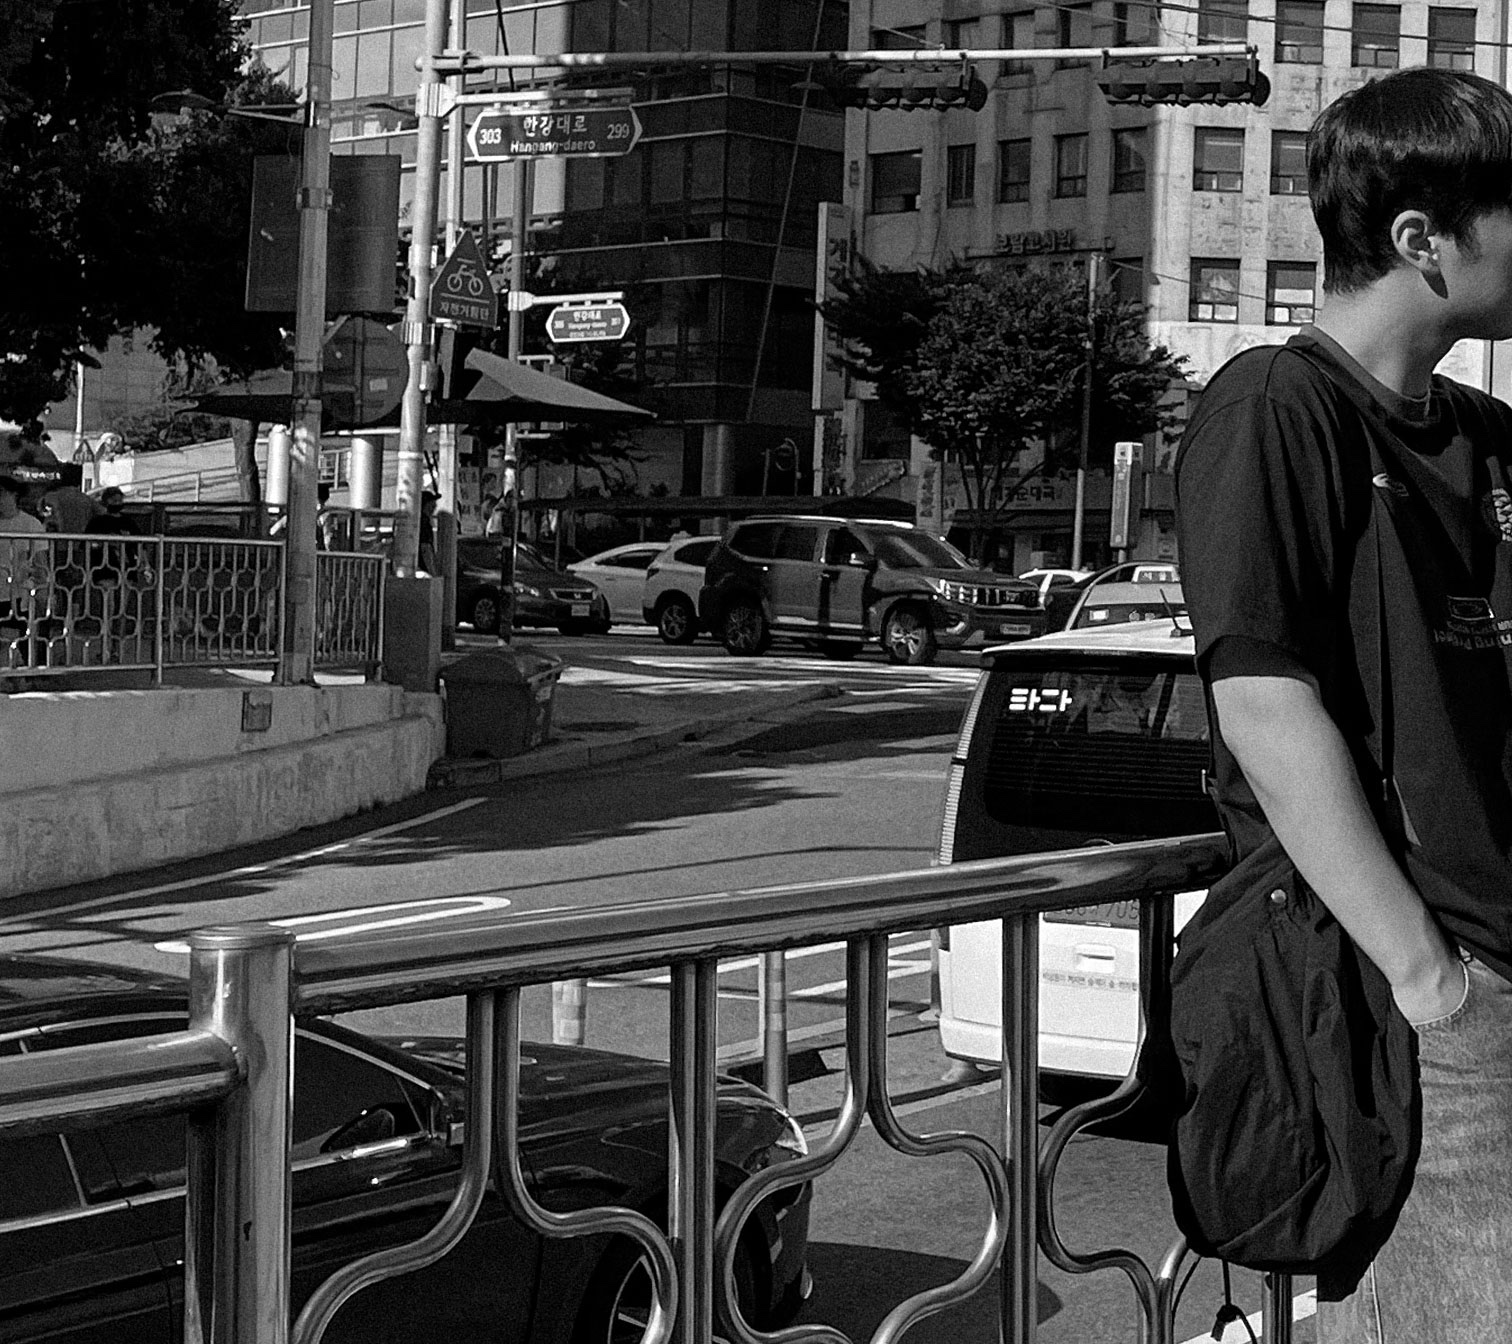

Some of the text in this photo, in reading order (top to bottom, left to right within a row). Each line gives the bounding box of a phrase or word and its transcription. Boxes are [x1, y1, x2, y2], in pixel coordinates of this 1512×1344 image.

[524, 115, 588, 138] 한강대로
[607, 124, 630, 140] 299
[479, 128, 502, 145] 303
[510, 140, 596, 154] Hangang-daero
